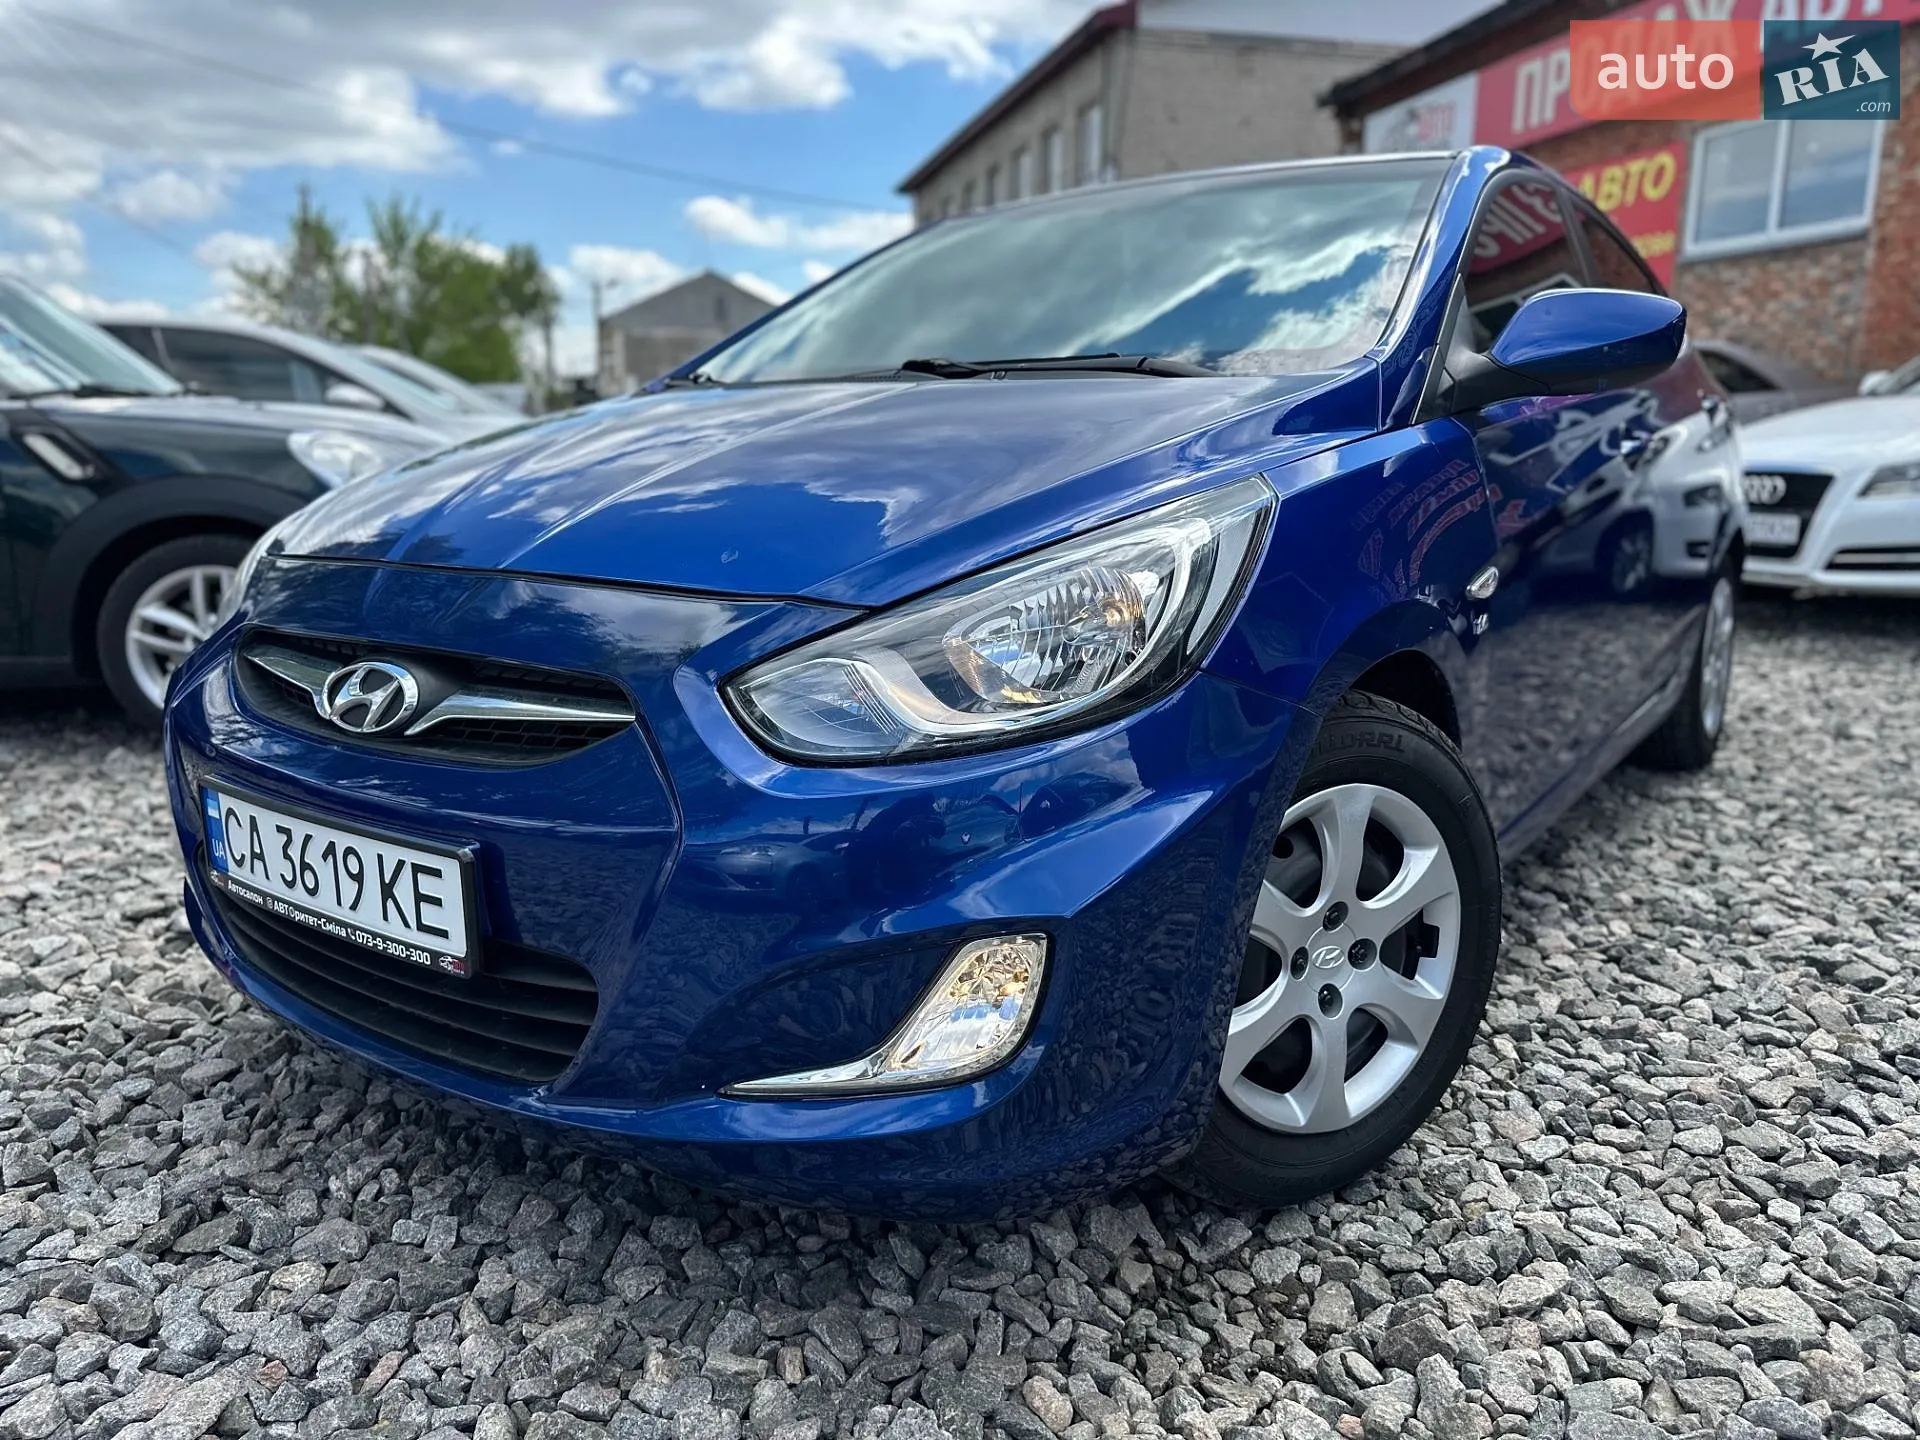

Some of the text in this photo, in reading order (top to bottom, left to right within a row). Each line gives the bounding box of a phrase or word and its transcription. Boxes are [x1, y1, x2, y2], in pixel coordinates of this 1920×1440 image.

[212, 838, 226, 860] UA
[224, 806, 449, 940] CA 3619 KE
[355, 930, 432, 965] 073-9-300-300
